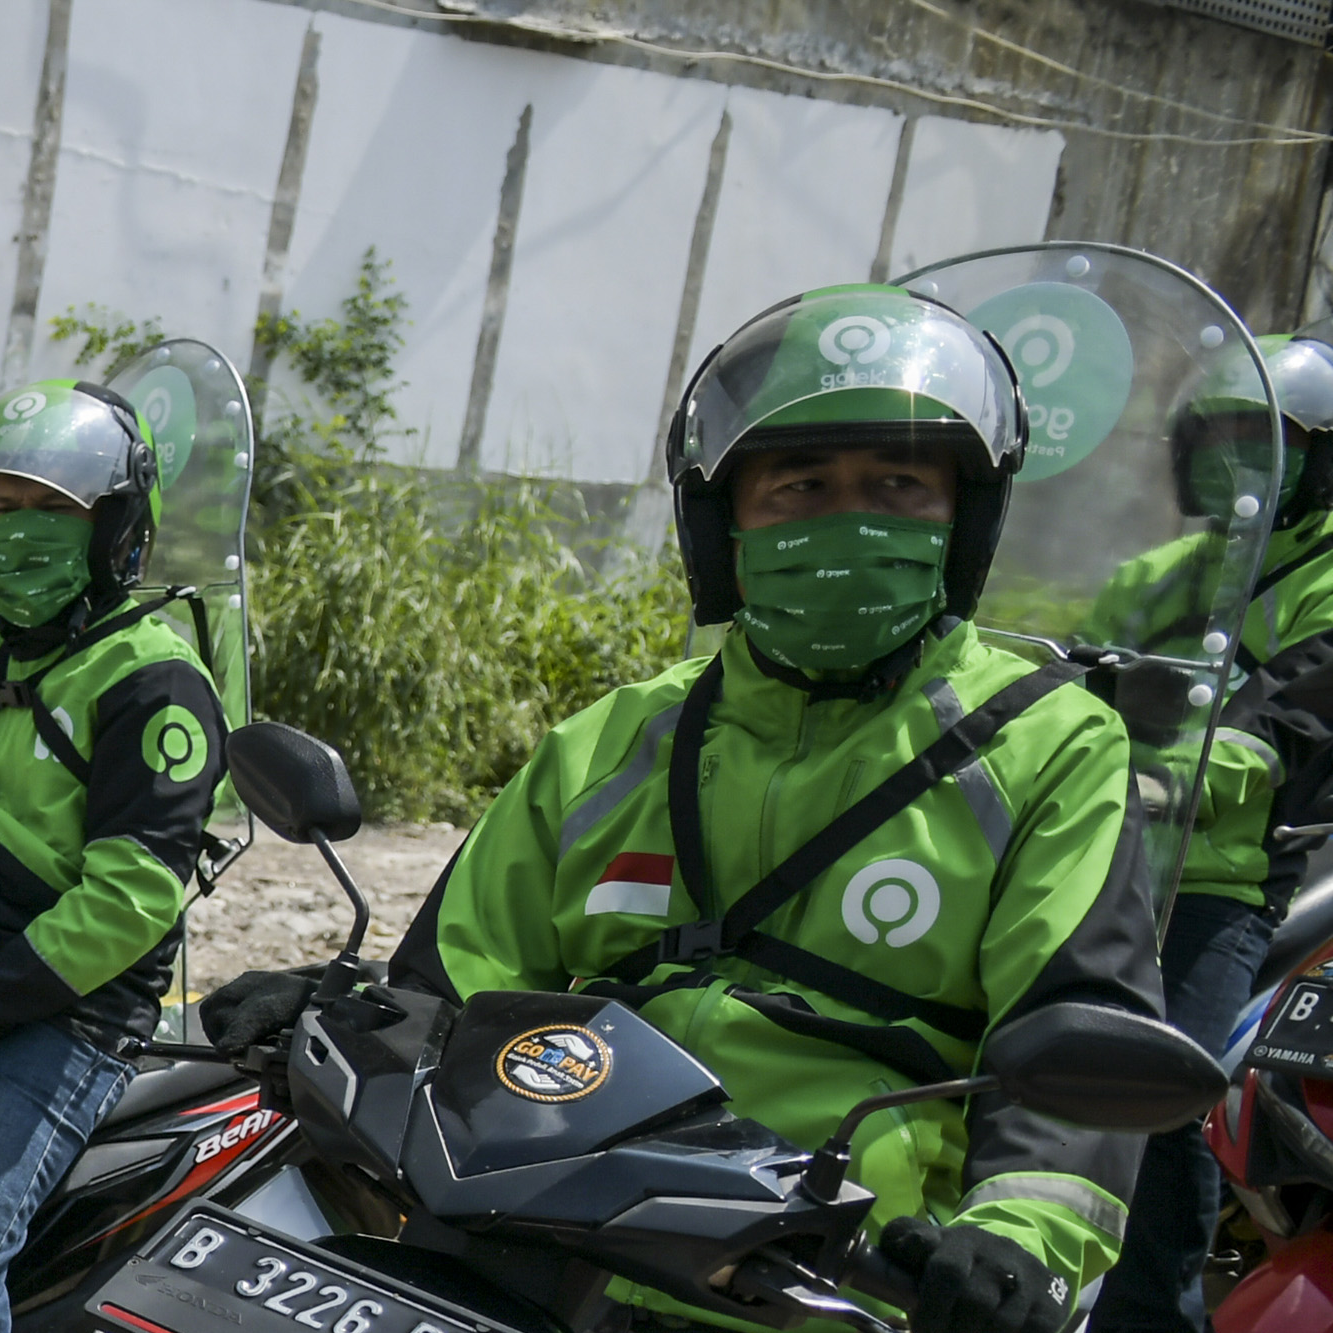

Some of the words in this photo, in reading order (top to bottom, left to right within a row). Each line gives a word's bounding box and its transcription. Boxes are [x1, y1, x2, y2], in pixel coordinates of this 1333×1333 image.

[1289, 991, 1319, 1021] B
[517, 1041, 545, 1057] GO
[558, 1056, 599, 1082] PAY
[1267, 1047, 1315, 1065] YAMAHA
[169, 1226, 225, 1270] B
